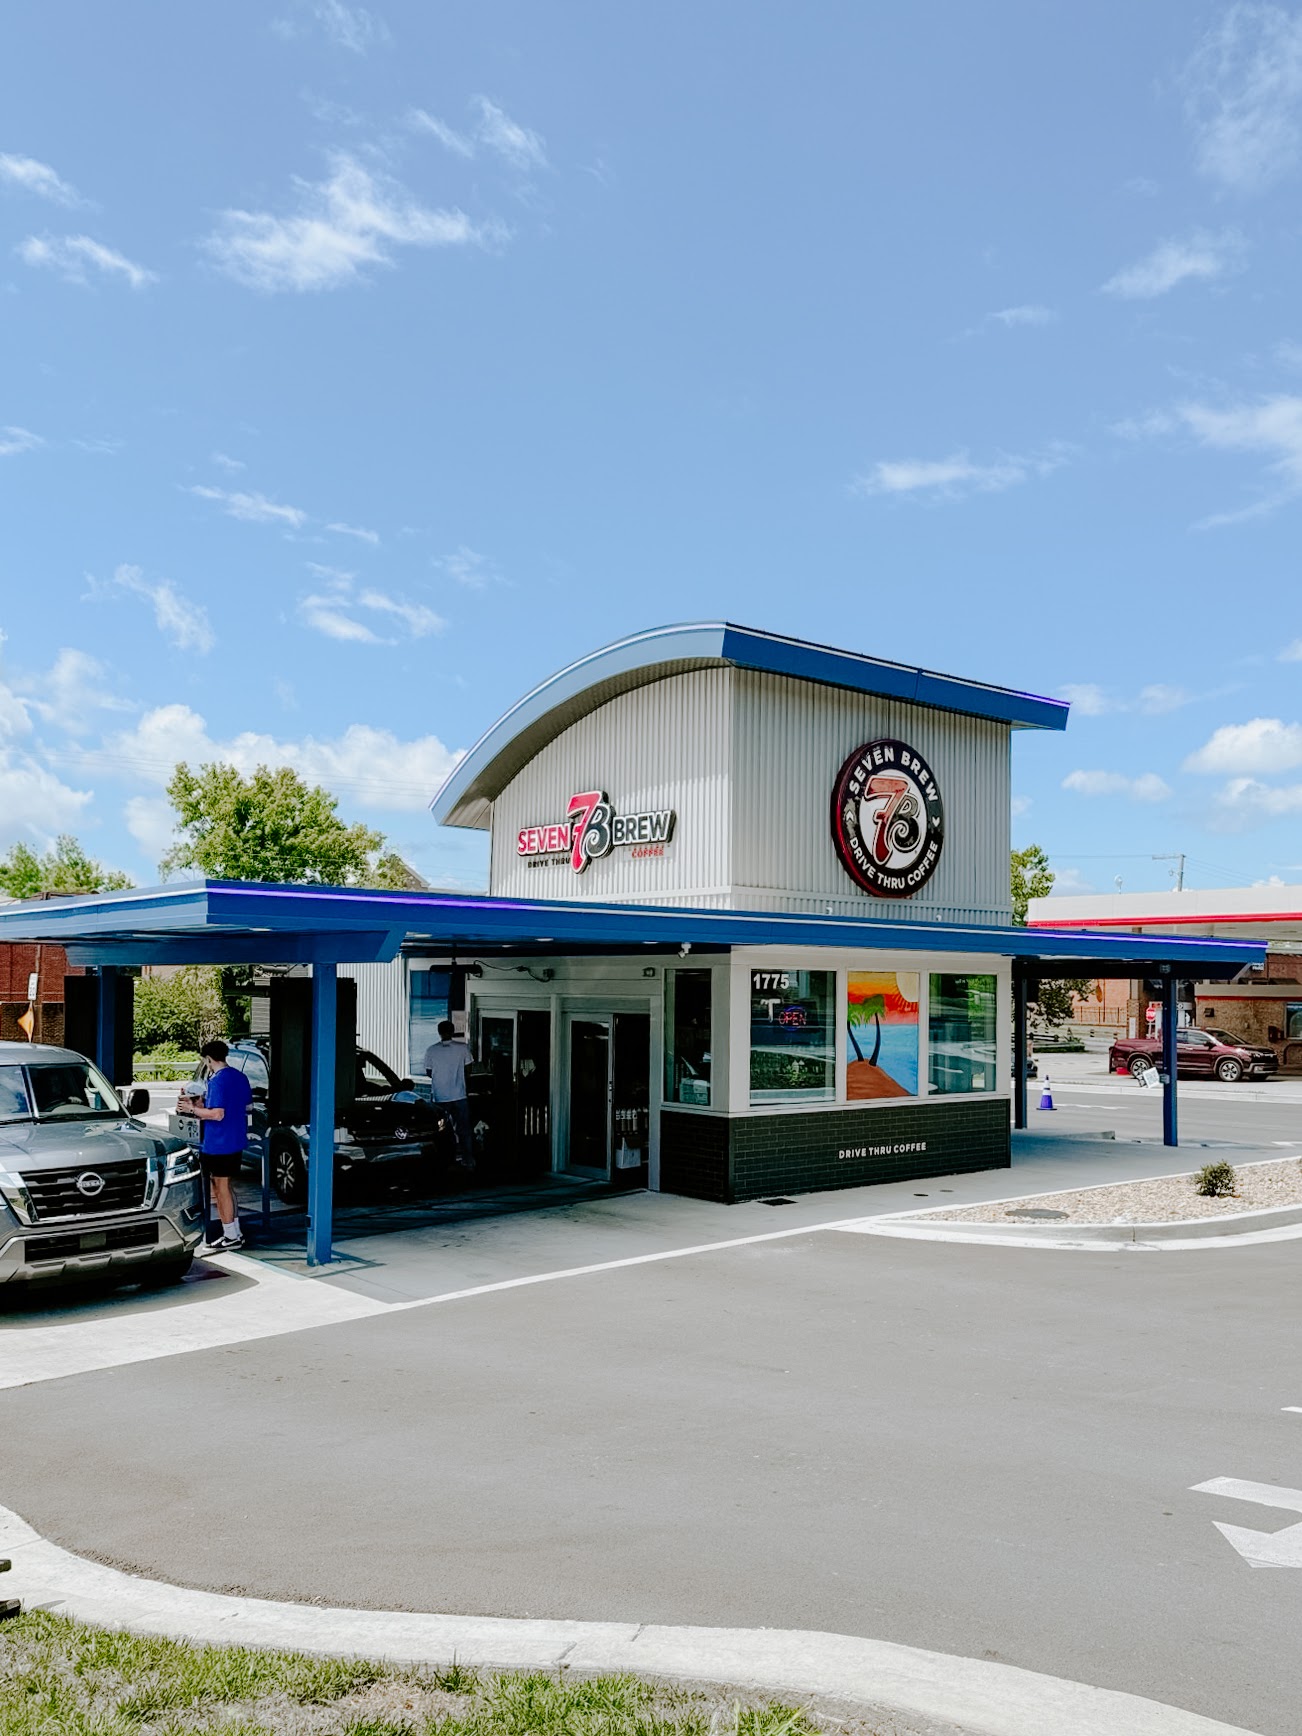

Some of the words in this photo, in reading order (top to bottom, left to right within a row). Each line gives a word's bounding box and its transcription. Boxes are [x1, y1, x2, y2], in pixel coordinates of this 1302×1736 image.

[850, 747, 895, 795] SEVEN
[901, 751, 938, 801] BREW
[517, 823, 570, 854] SEVEN
[613, 810, 670, 845] BREW
[632, 847, 664, 858] COFFEE
[528, 860, 548, 868] DRIVE
[850, 837, 876, 878] DRIVE
[877, 873, 905, 889] THRU
[907, 840, 938, 886] COFFEE
[753, 973, 790, 990] 1775
[838, 1148, 867, 1159] DRIVE
[868, 1145, 892, 1156] THRU
[893, 1142, 927, 1153] COFFEE
